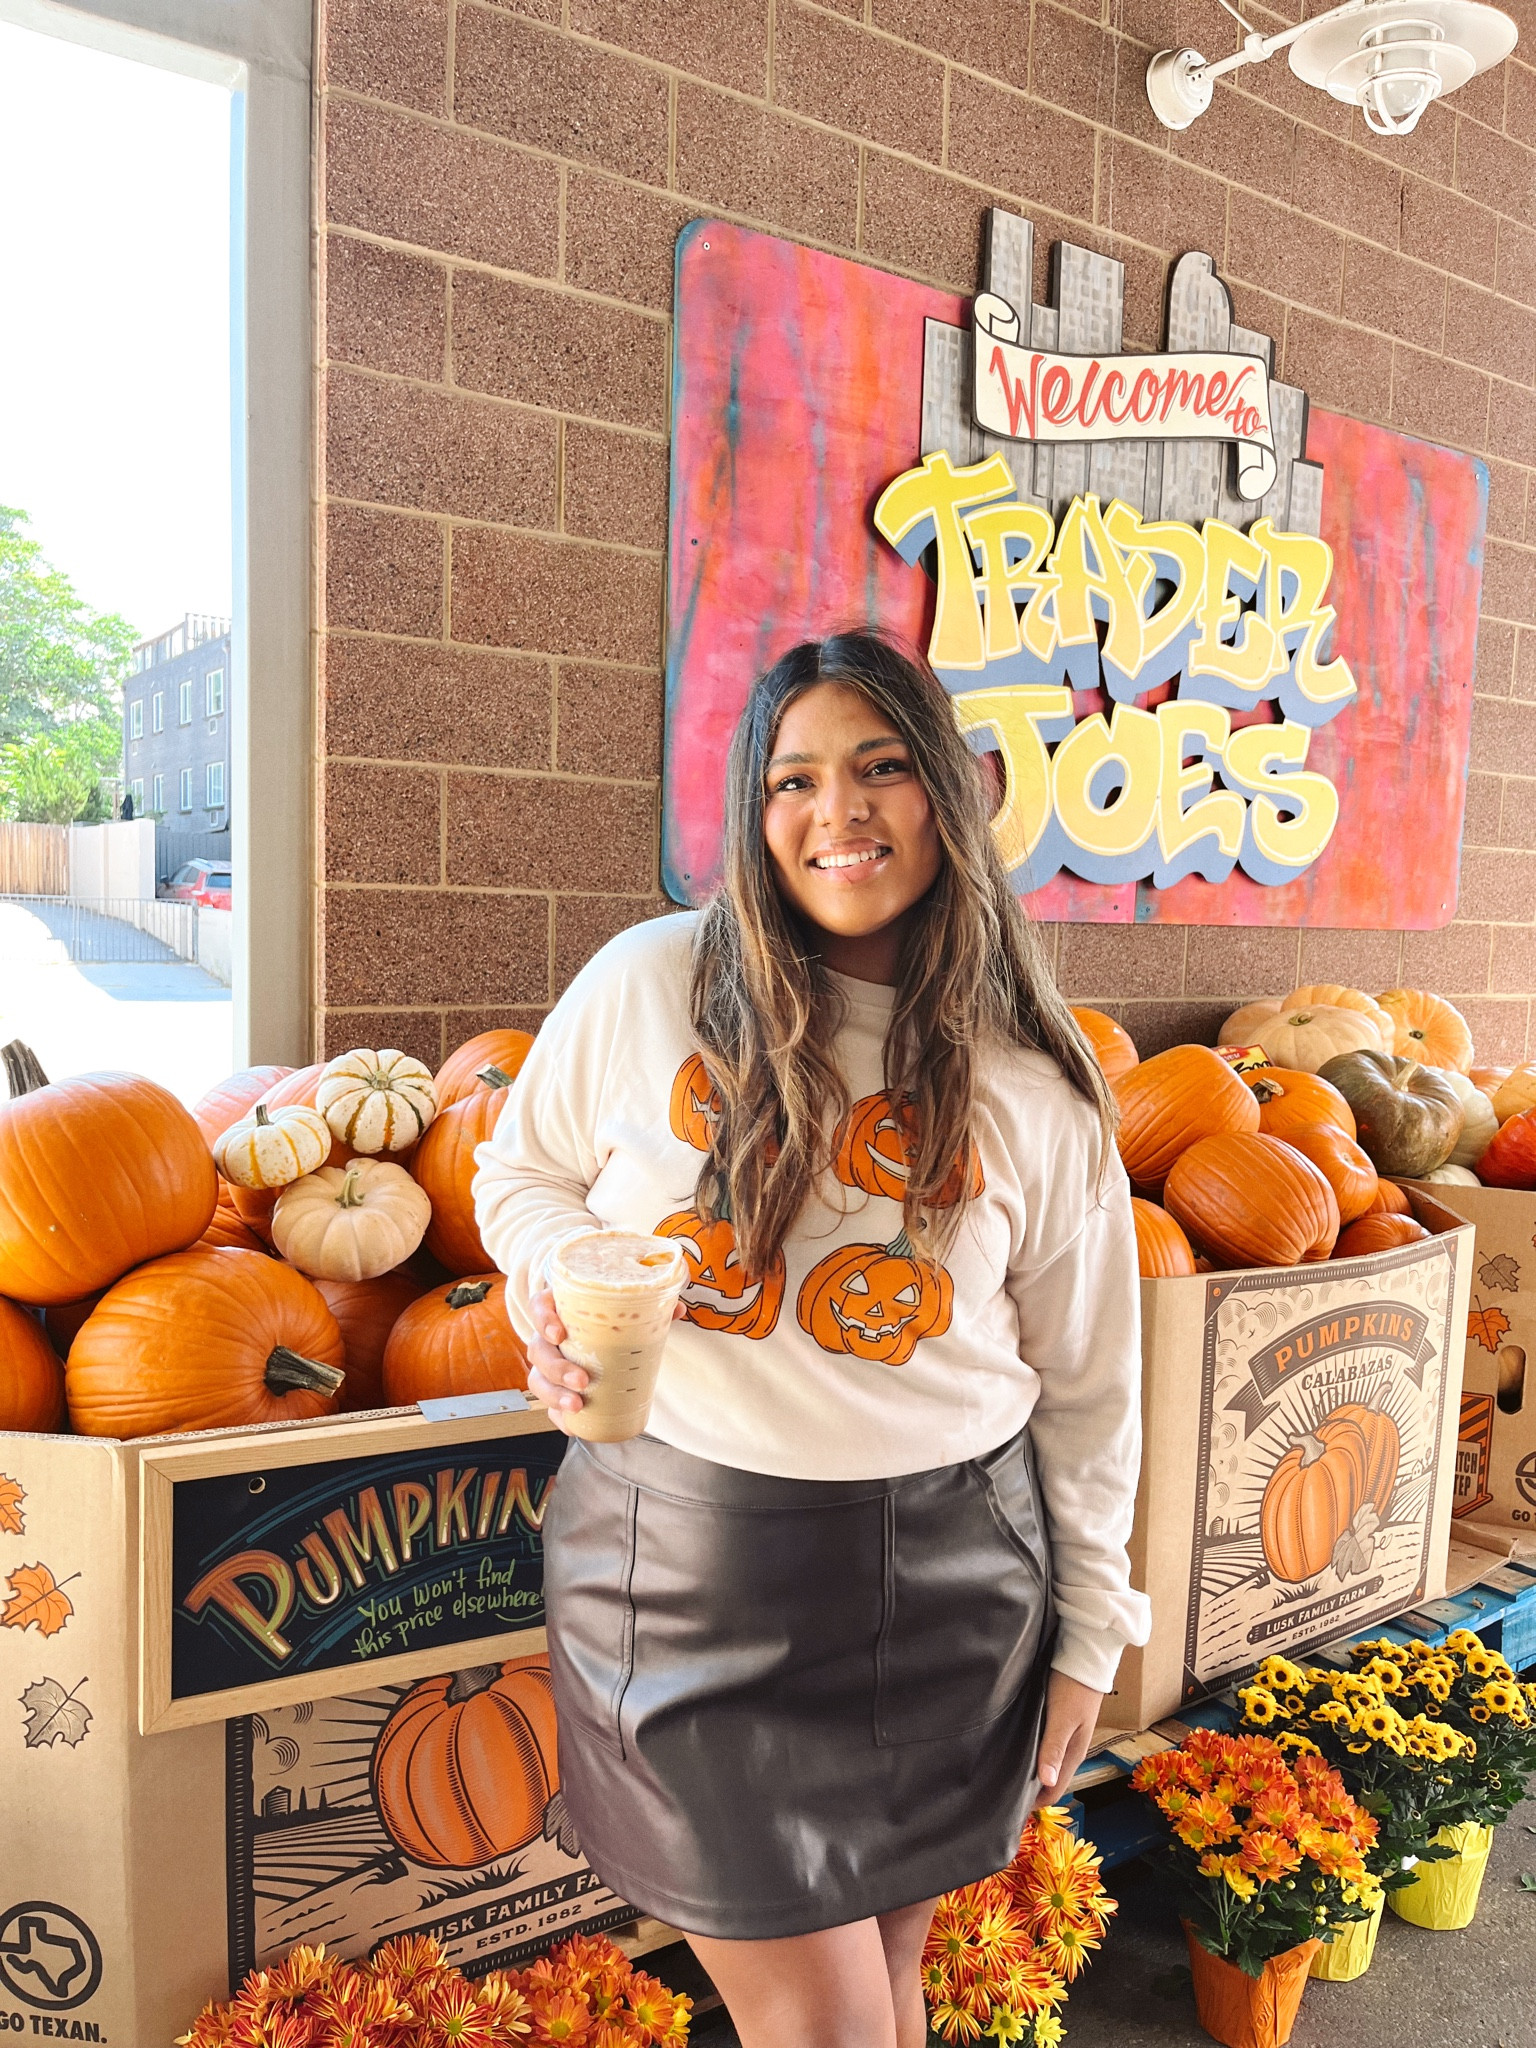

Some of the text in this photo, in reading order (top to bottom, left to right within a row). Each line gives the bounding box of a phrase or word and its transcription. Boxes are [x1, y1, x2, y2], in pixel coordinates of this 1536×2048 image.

[989, 345, 1268, 440] Welcome to
[874, 449, 1356, 704] TRADER
[951, 684, 1340, 867] JOES
[1273, 1312, 1415, 1374] PUMPKINS
[1301, 1354, 1394, 1391] CALABAZAS
[1454, 1474, 1472, 1497] TEP
[1455, 1450, 1478, 1475] TCH
[1511, 1509, 1531, 1523] GO
[357, 1595, 403, 1628] You
[475, 1556, 516, 1590] find
[1265, 1585, 1367, 1636] LUSK FAMILY FARM
[351, 1627, 393, 1659] this
[392, 1605, 443, 1647] price
[1292, 1614, 1341, 1640] ESTD. 1982
[485, 1884, 567, 1925] FAMILY
[575, 1873, 601, 1893] FA
[476, 1903, 583, 1950] ESTD. 1982
[0, 2010, 108, 2044] GO TEXAN.
